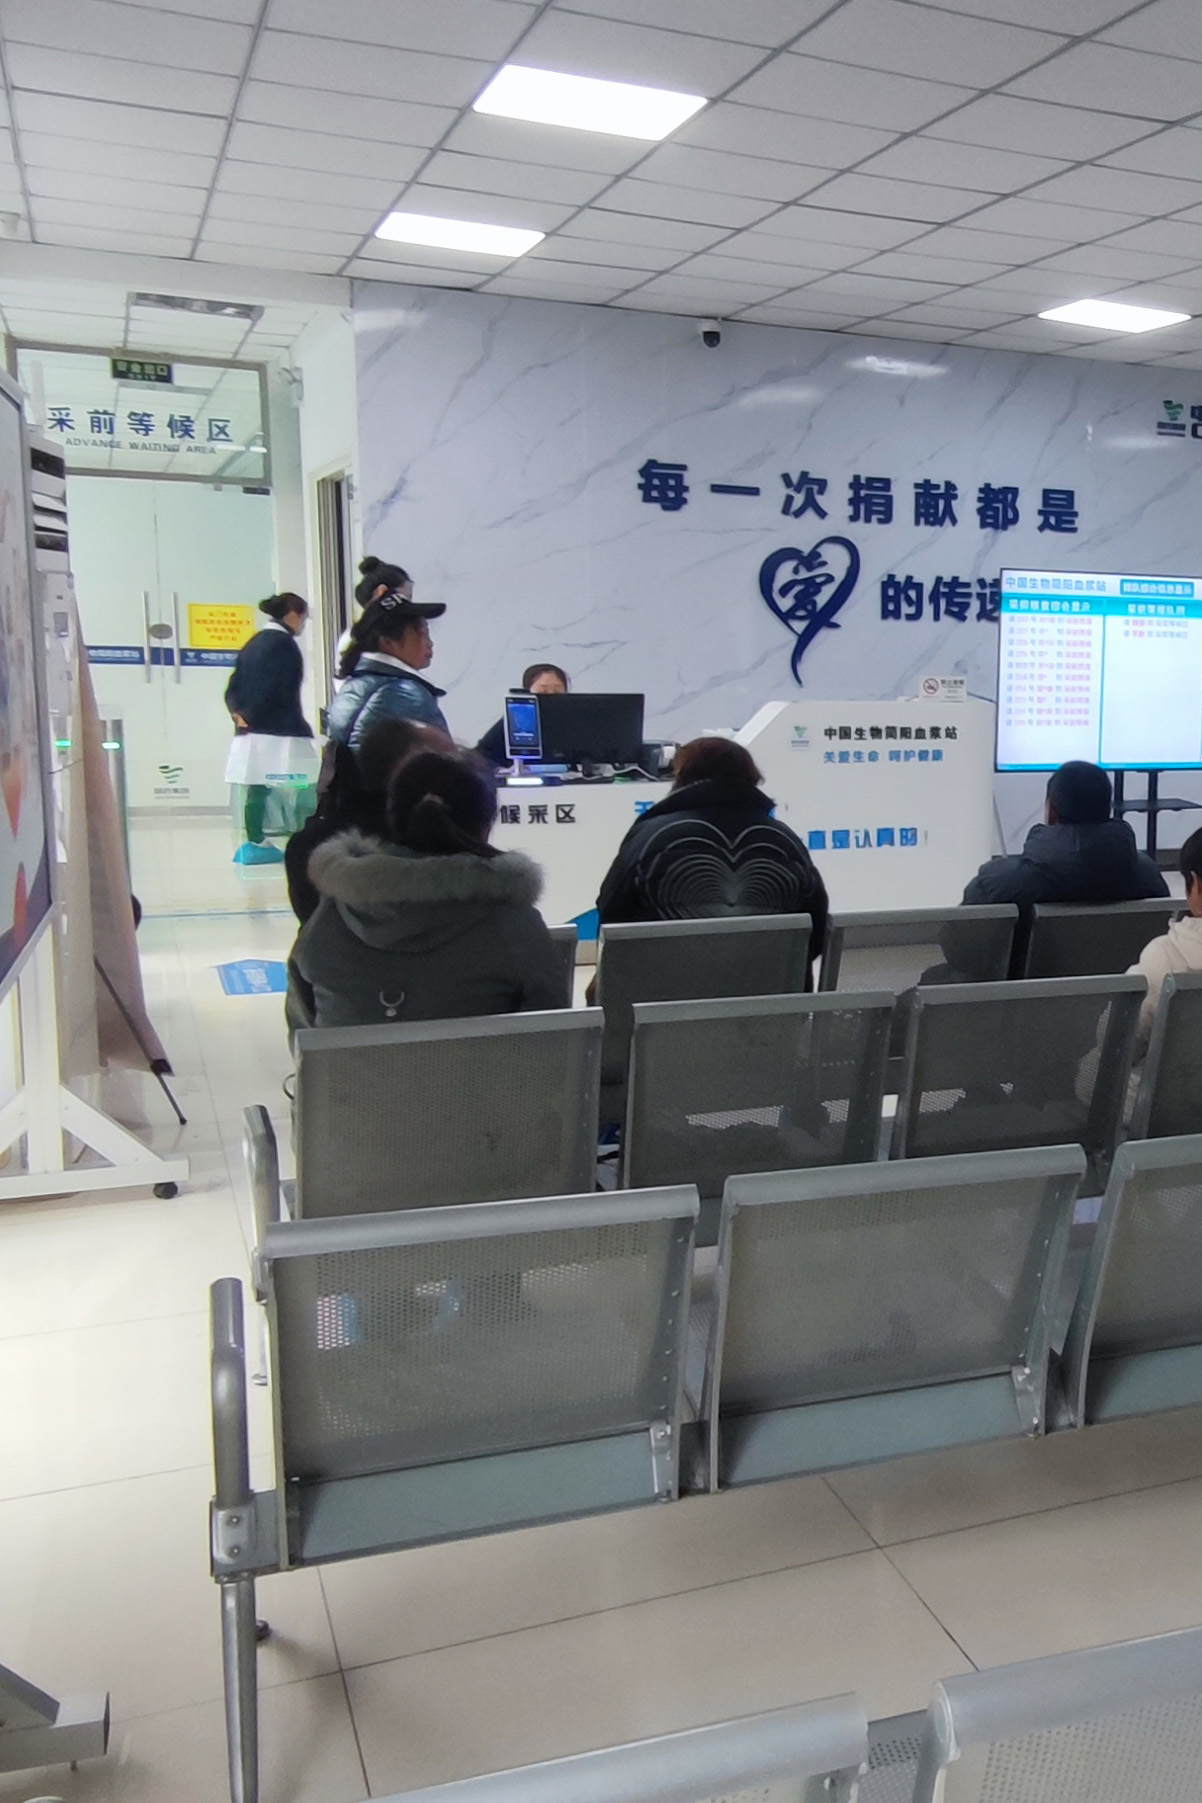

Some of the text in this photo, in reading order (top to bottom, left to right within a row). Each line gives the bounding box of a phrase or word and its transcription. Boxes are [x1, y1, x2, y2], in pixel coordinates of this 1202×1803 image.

[47, 406, 234, 443] 采前等候区
[65, 437, 217, 456] ADVANCE WAITING AREA
[637, 459, 1080, 534] 每一次捐献都是
[823, 726, 958, 740] 中国生物简阳血浆站
[823, 749, 944, 763] 关爱生命 呵护健康
[500, 804, 576, 824] 候采区
